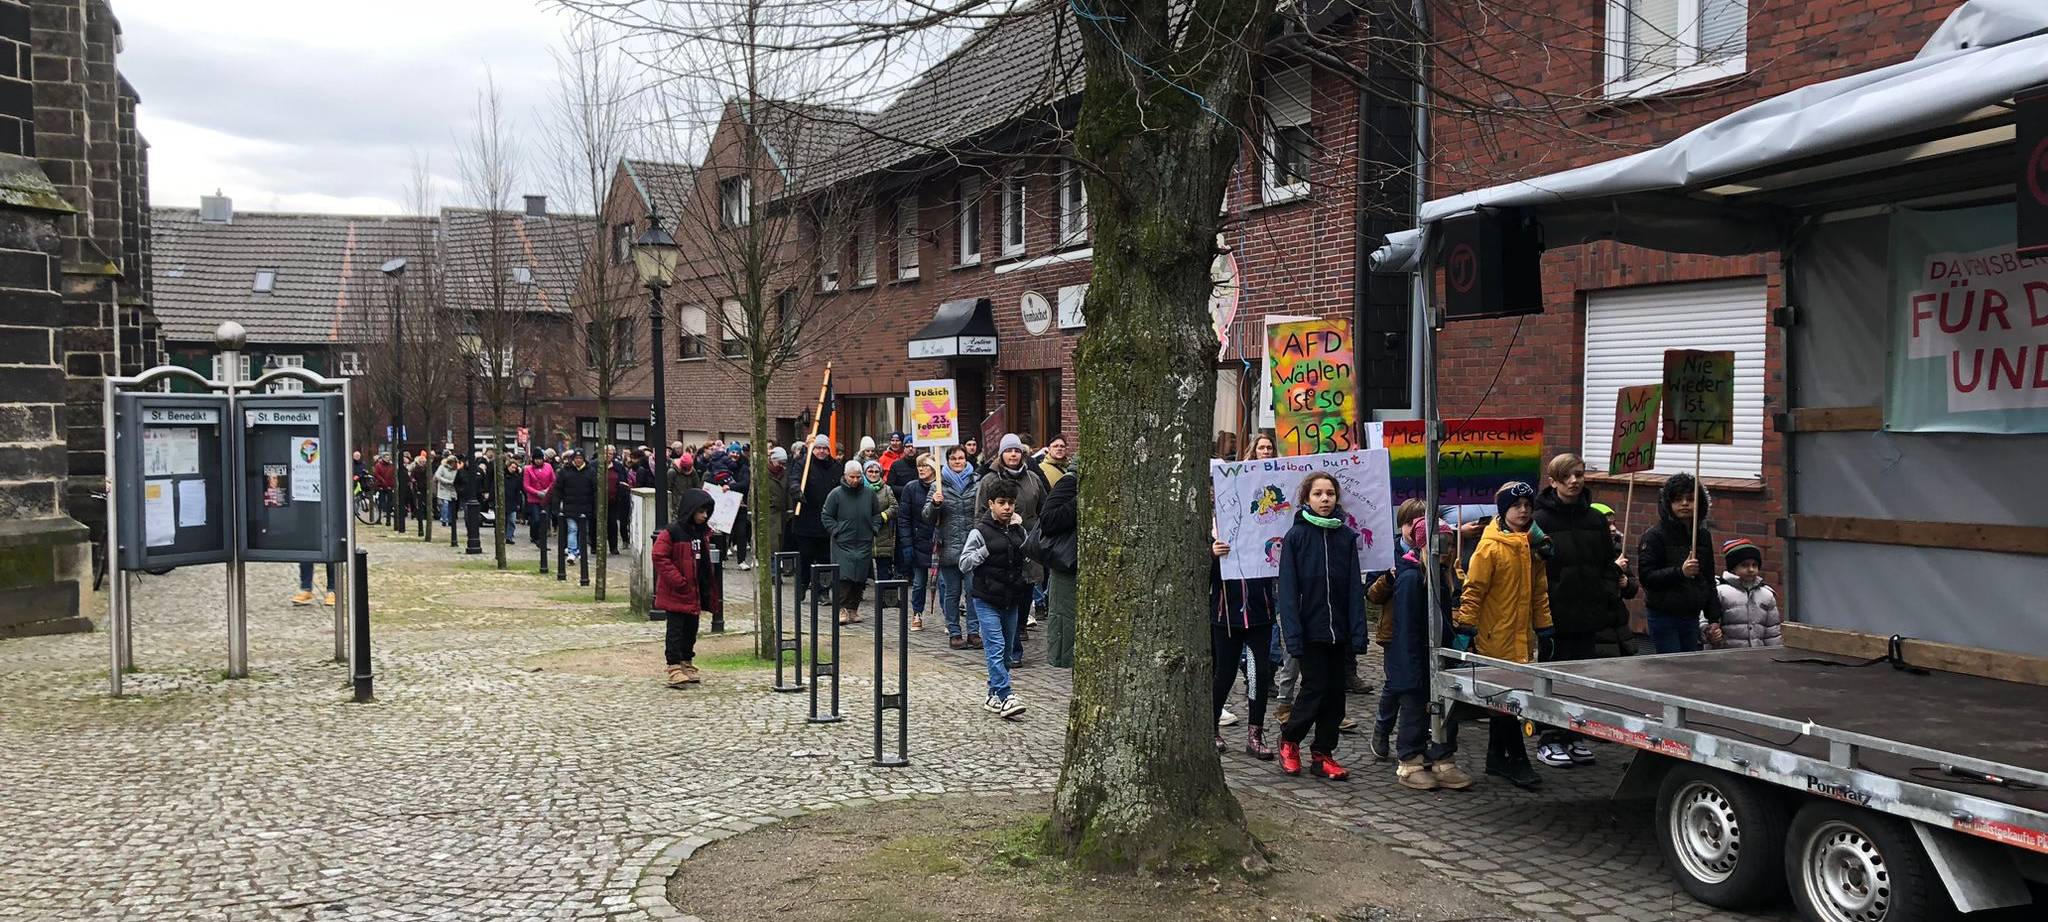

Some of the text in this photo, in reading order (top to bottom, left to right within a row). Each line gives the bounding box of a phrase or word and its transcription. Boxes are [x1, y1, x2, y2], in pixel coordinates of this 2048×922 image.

[1912, 279, 2012, 339] FÜR
[1282, 331, 1342, 357] AFD
[1683, 356, 1713, 375] Nie
[1288, 389, 1345, 412] ist so
[1684, 395, 1706, 413] ist
[152, 410, 207, 421] St. Benedikt
[258, 412, 312, 422] St. Benedikt
[932, 415, 950, 423] 23.
[1665, 418, 1730, 441] JETZT
[1218, 464, 1256, 478] Wir
[1323, 454, 1364, 467] bunt.
[1438, 450, 1504, 470] STATT
